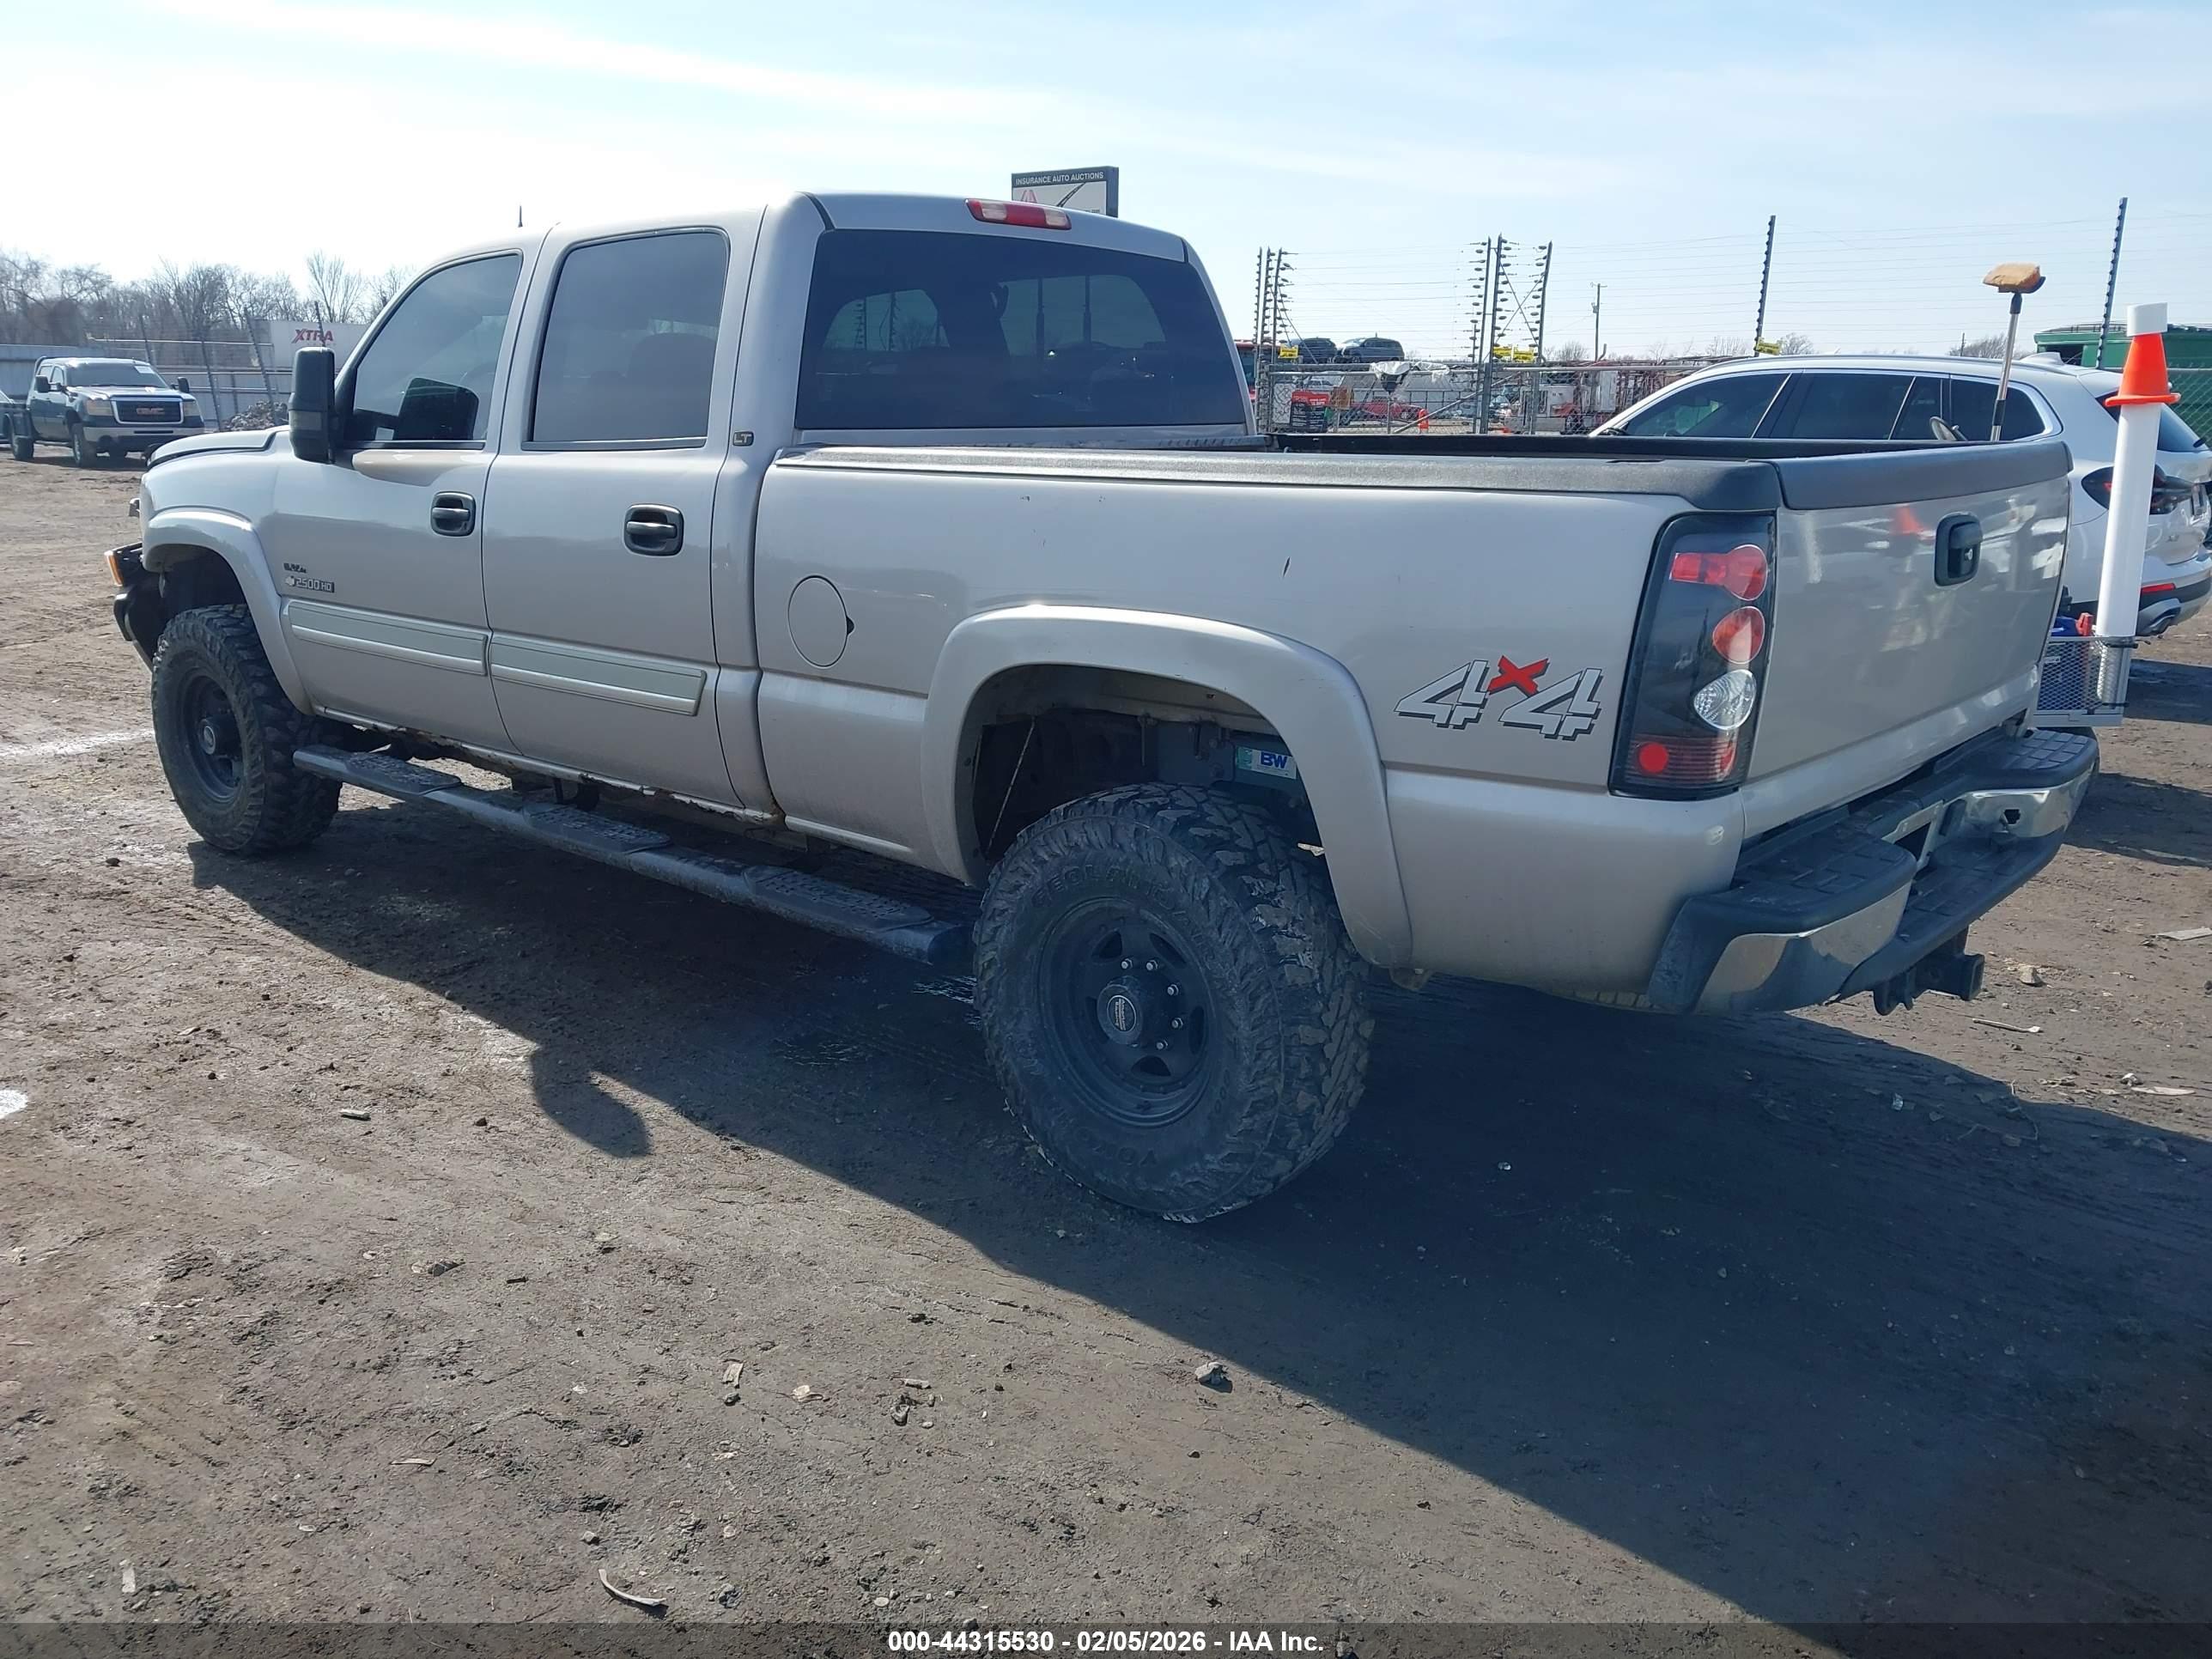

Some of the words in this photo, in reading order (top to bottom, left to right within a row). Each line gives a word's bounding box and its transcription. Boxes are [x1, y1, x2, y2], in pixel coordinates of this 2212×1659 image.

[1015, 176, 1052, 185] INSURANCE
[1070, 172, 1104, 181] AUCTIONS
[734, 433, 752, 443] LT
